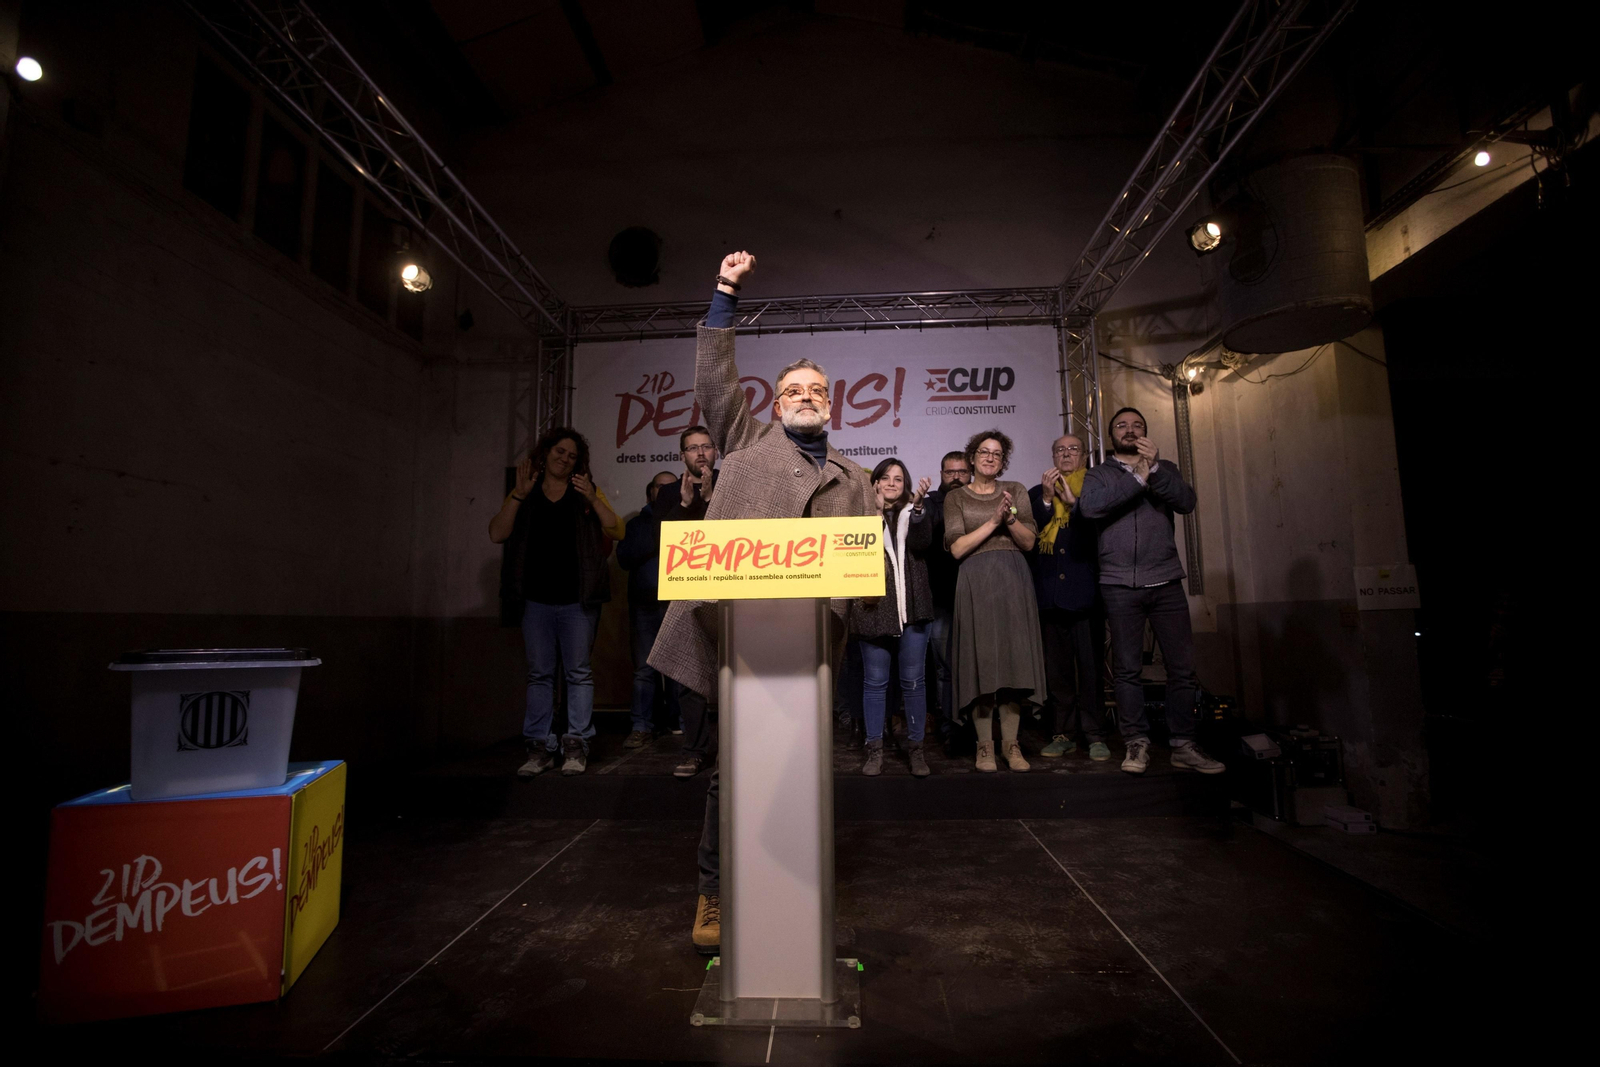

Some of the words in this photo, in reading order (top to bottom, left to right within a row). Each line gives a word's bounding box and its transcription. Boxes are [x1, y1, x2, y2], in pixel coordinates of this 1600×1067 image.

[636, 371, 675, 394] 21D
[947, 366, 1016, 400] cup
[615, 367, 903, 449] DEPUS!
[925, 405, 1016, 416] CRIDACONSTITUENT
[616, 452, 646, 463] drets
[650, 451, 682, 462] social
[838, 445, 898, 456] onstituent
[680, 529, 705, 546] 21D
[843, 533, 877, 549] cup
[666, 534, 827, 575] DEMPEUS!
[748, 573, 784, 581] assemblea
[785, 572, 822, 580] constituent
[1359, 588, 1374, 596] NO
[1378, 586, 1416, 595] PASSAR
[301, 825, 319, 876] 21D
[91, 854, 163, 906] 21D
[290, 804, 344, 934] DEMPEUS!
[48, 847, 283, 965] DEMPEUS!
